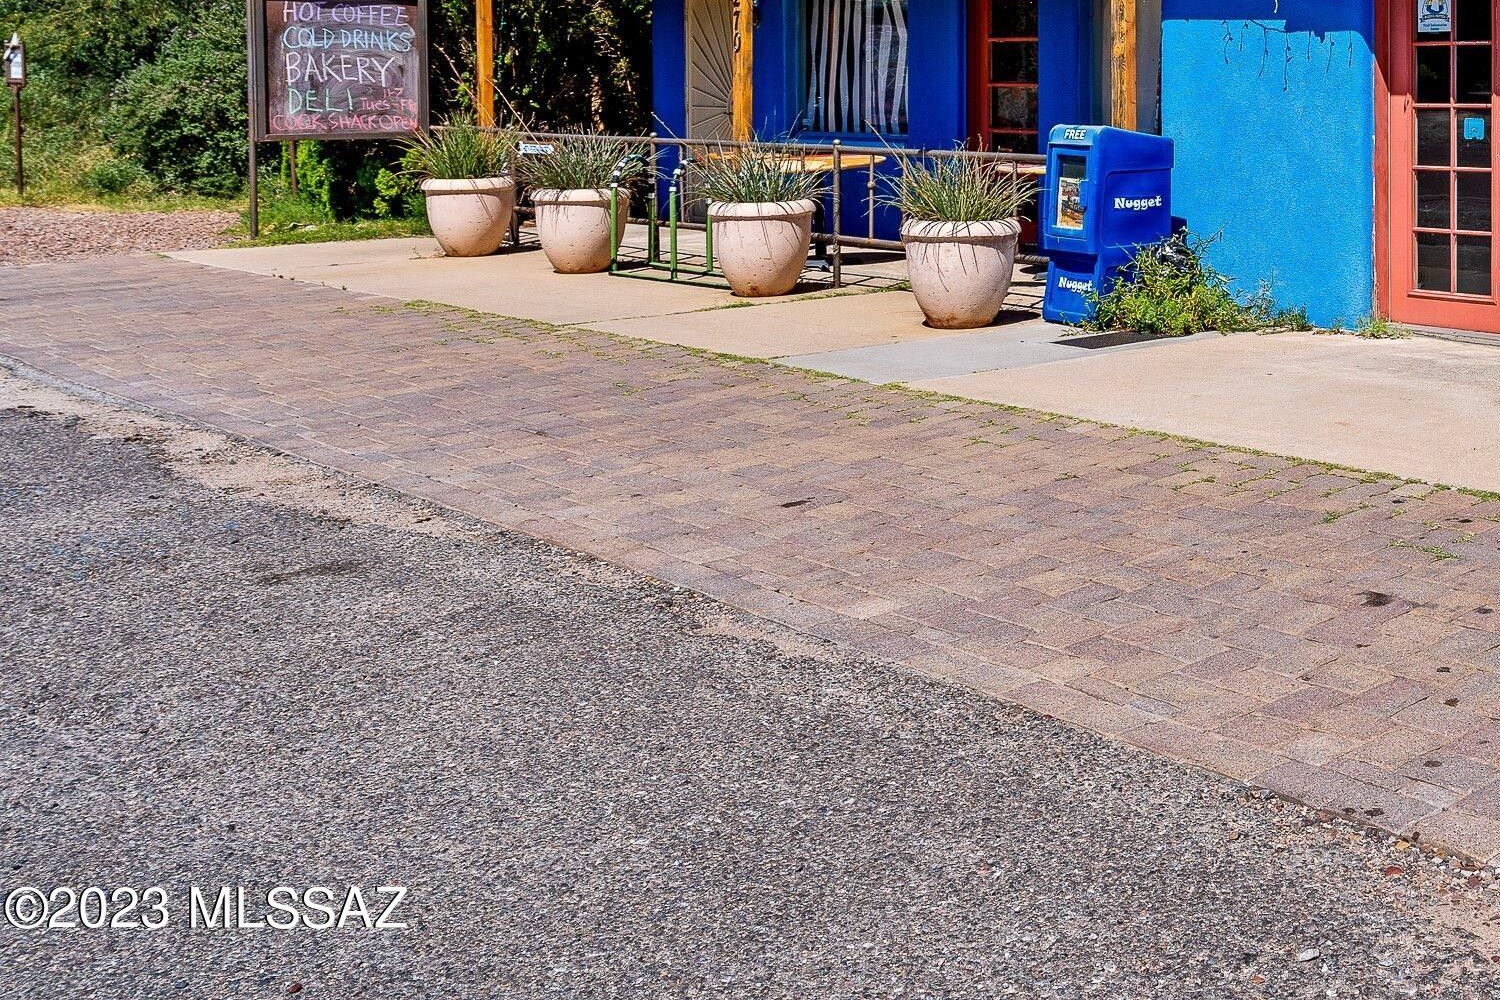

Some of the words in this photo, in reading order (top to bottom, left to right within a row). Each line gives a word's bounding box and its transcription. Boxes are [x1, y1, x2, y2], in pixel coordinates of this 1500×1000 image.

[283, 1, 326, 23] HOT
[331, 3, 408, 26] COFFEE
[283, 26, 335, 49] COLD
[340, 29, 412, 52] DRINKS
[285, 51, 396, 88] BAKERY
[273, 113, 327, 130] COOK
[328, 112, 377, 130] SHACK
[1063, 128, 1087, 140] FREE
[1114, 195, 1162, 211] Nugget
[1058, 276, 1093, 293] Nugget
